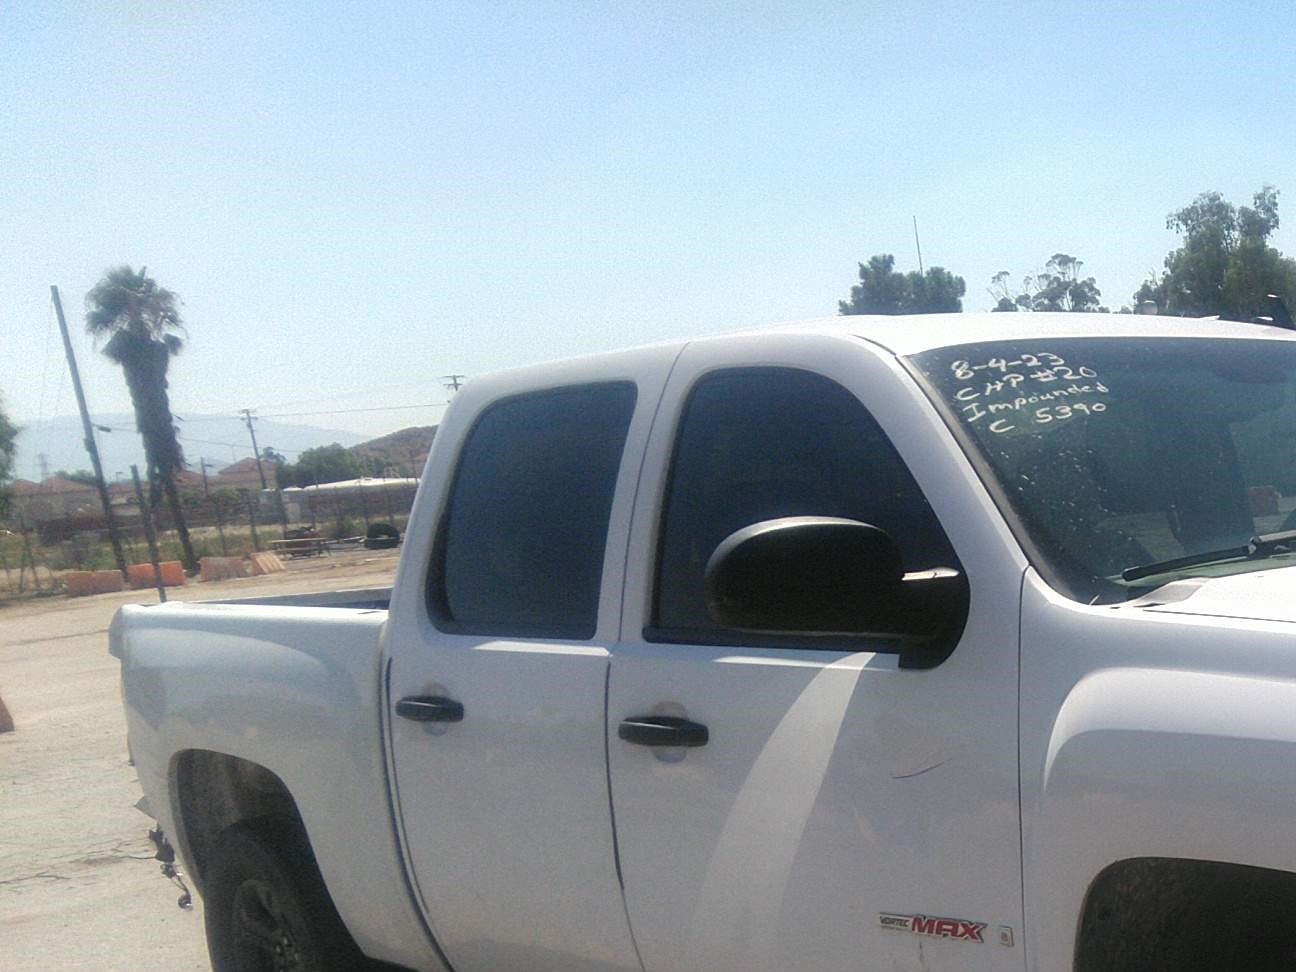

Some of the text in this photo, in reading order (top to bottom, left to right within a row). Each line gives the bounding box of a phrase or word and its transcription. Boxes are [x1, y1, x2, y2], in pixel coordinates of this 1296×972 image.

[951, 352, 1065, 380] 8-4-23
[962, 382, 1109, 422] Impounded
[911, 916, 986, 943] MAX
